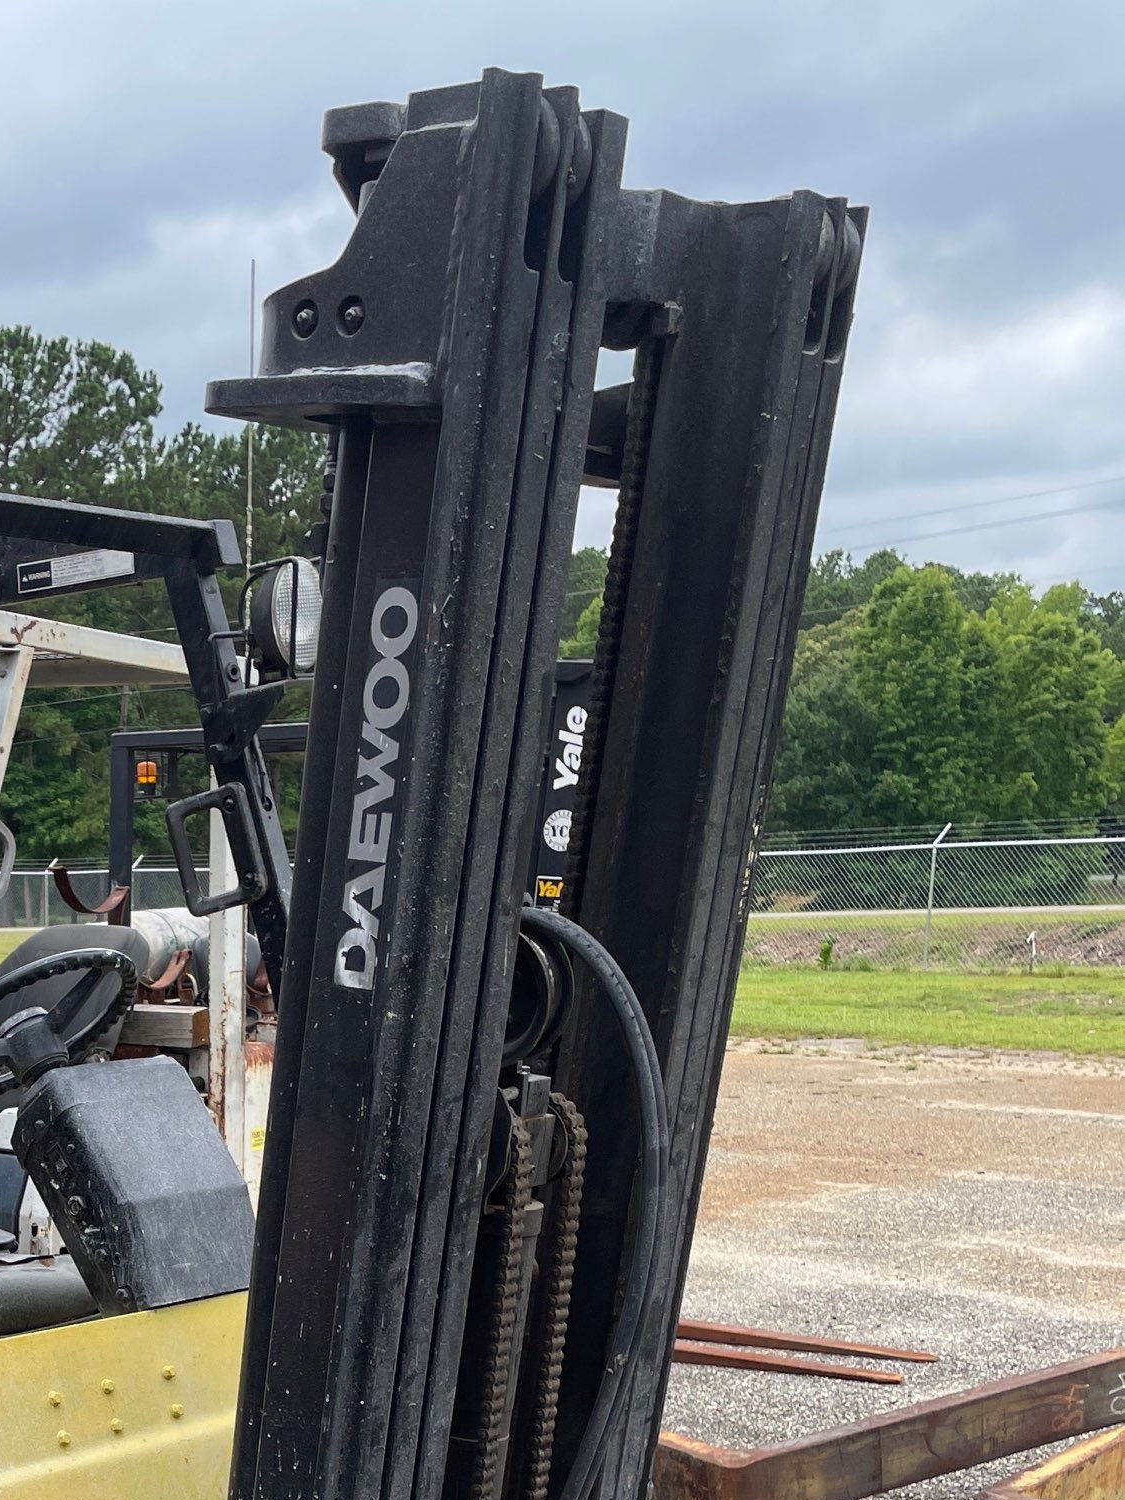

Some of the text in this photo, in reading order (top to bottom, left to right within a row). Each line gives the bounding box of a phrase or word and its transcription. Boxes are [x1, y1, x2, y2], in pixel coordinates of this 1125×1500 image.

[333, 586, 418, 991] DAEWOO
[553, 705, 588, 790] Yale
[538, 880, 564, 898] Yal
